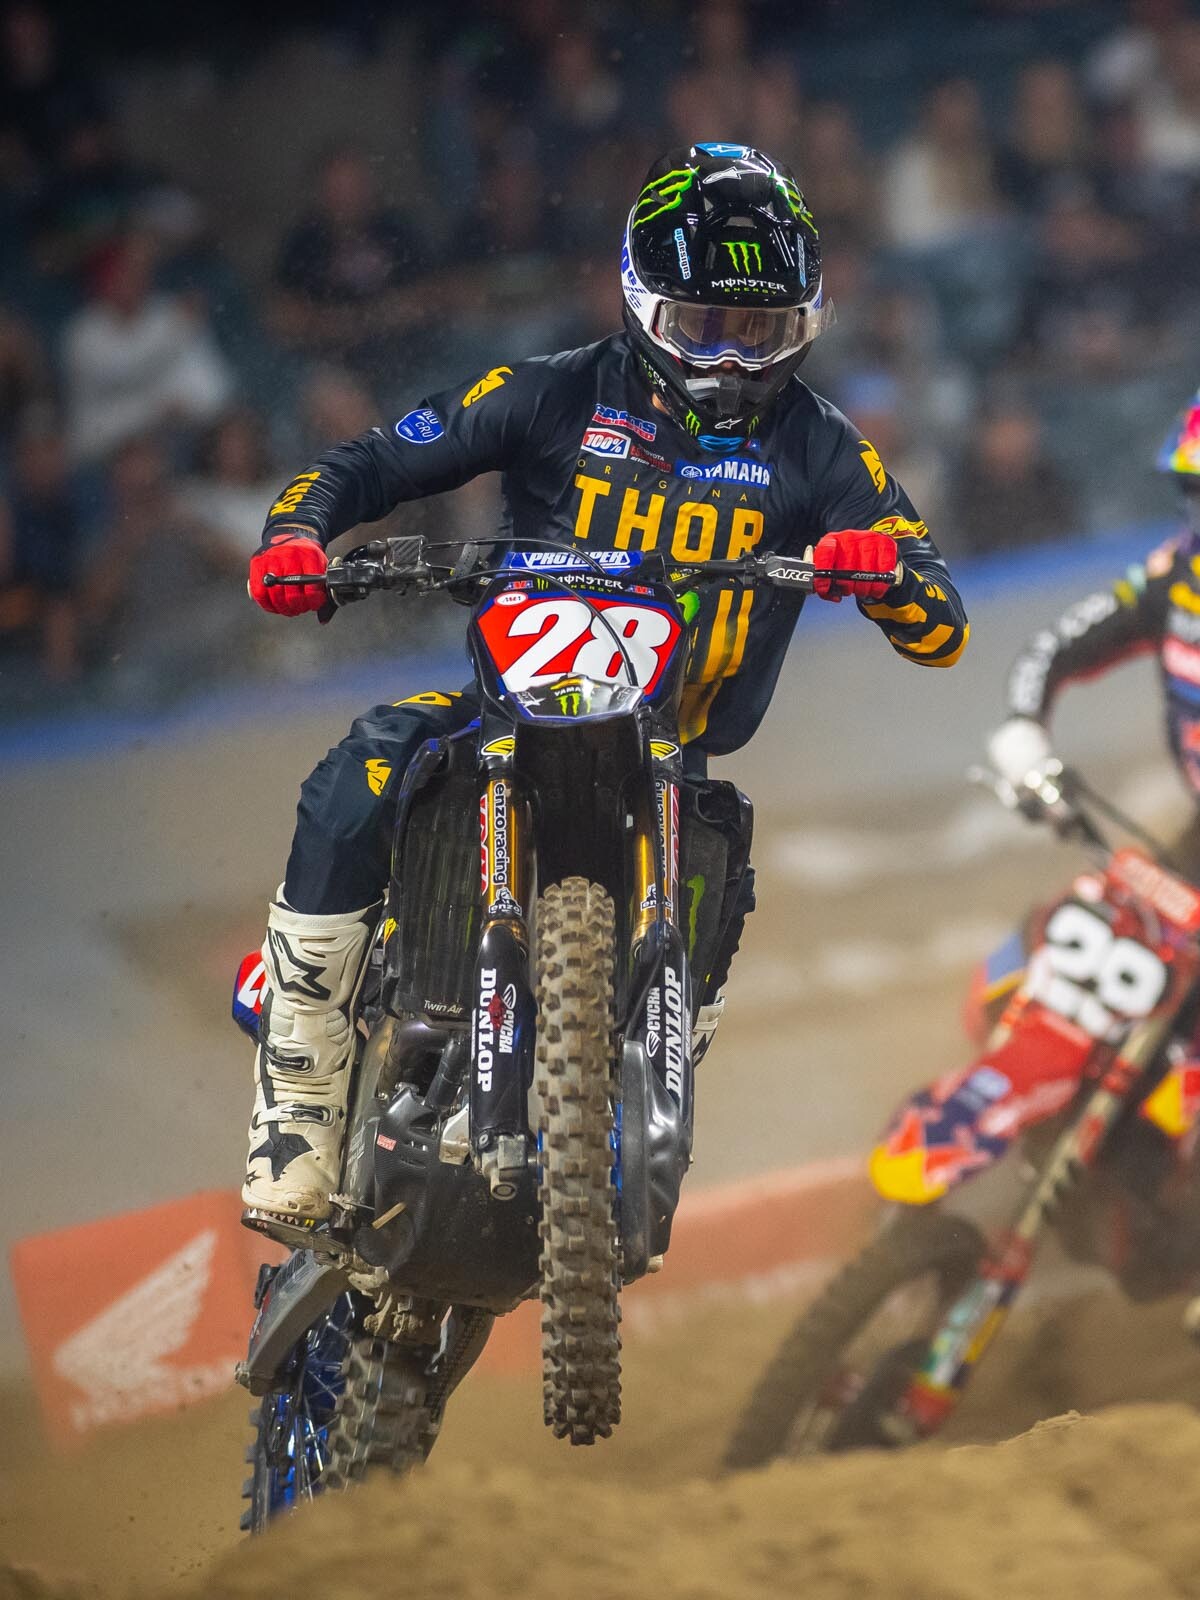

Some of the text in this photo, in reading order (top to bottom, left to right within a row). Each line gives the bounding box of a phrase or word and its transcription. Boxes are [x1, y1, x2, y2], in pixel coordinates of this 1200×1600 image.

[711, 277, 788, 293] MONSTER
[724, 287, 777, 295] ENERGY
[585, 433, 624, 453] 100%
[704, 460, 770, 485] YAMAHA
[574, 473, 764, 563] THOR
[768, 567, 814, 582] ARC
[501, 600, 672, 694] 28
[493, 783, 507, 885] enzoracing
[424, 1000, 463, 1014] Twin Air
[646, 987, 661, 1031] CYCRA
[477, 968, 497, 1092] DUNLOP
[664, 966, 682, 1099] DUNLOP
